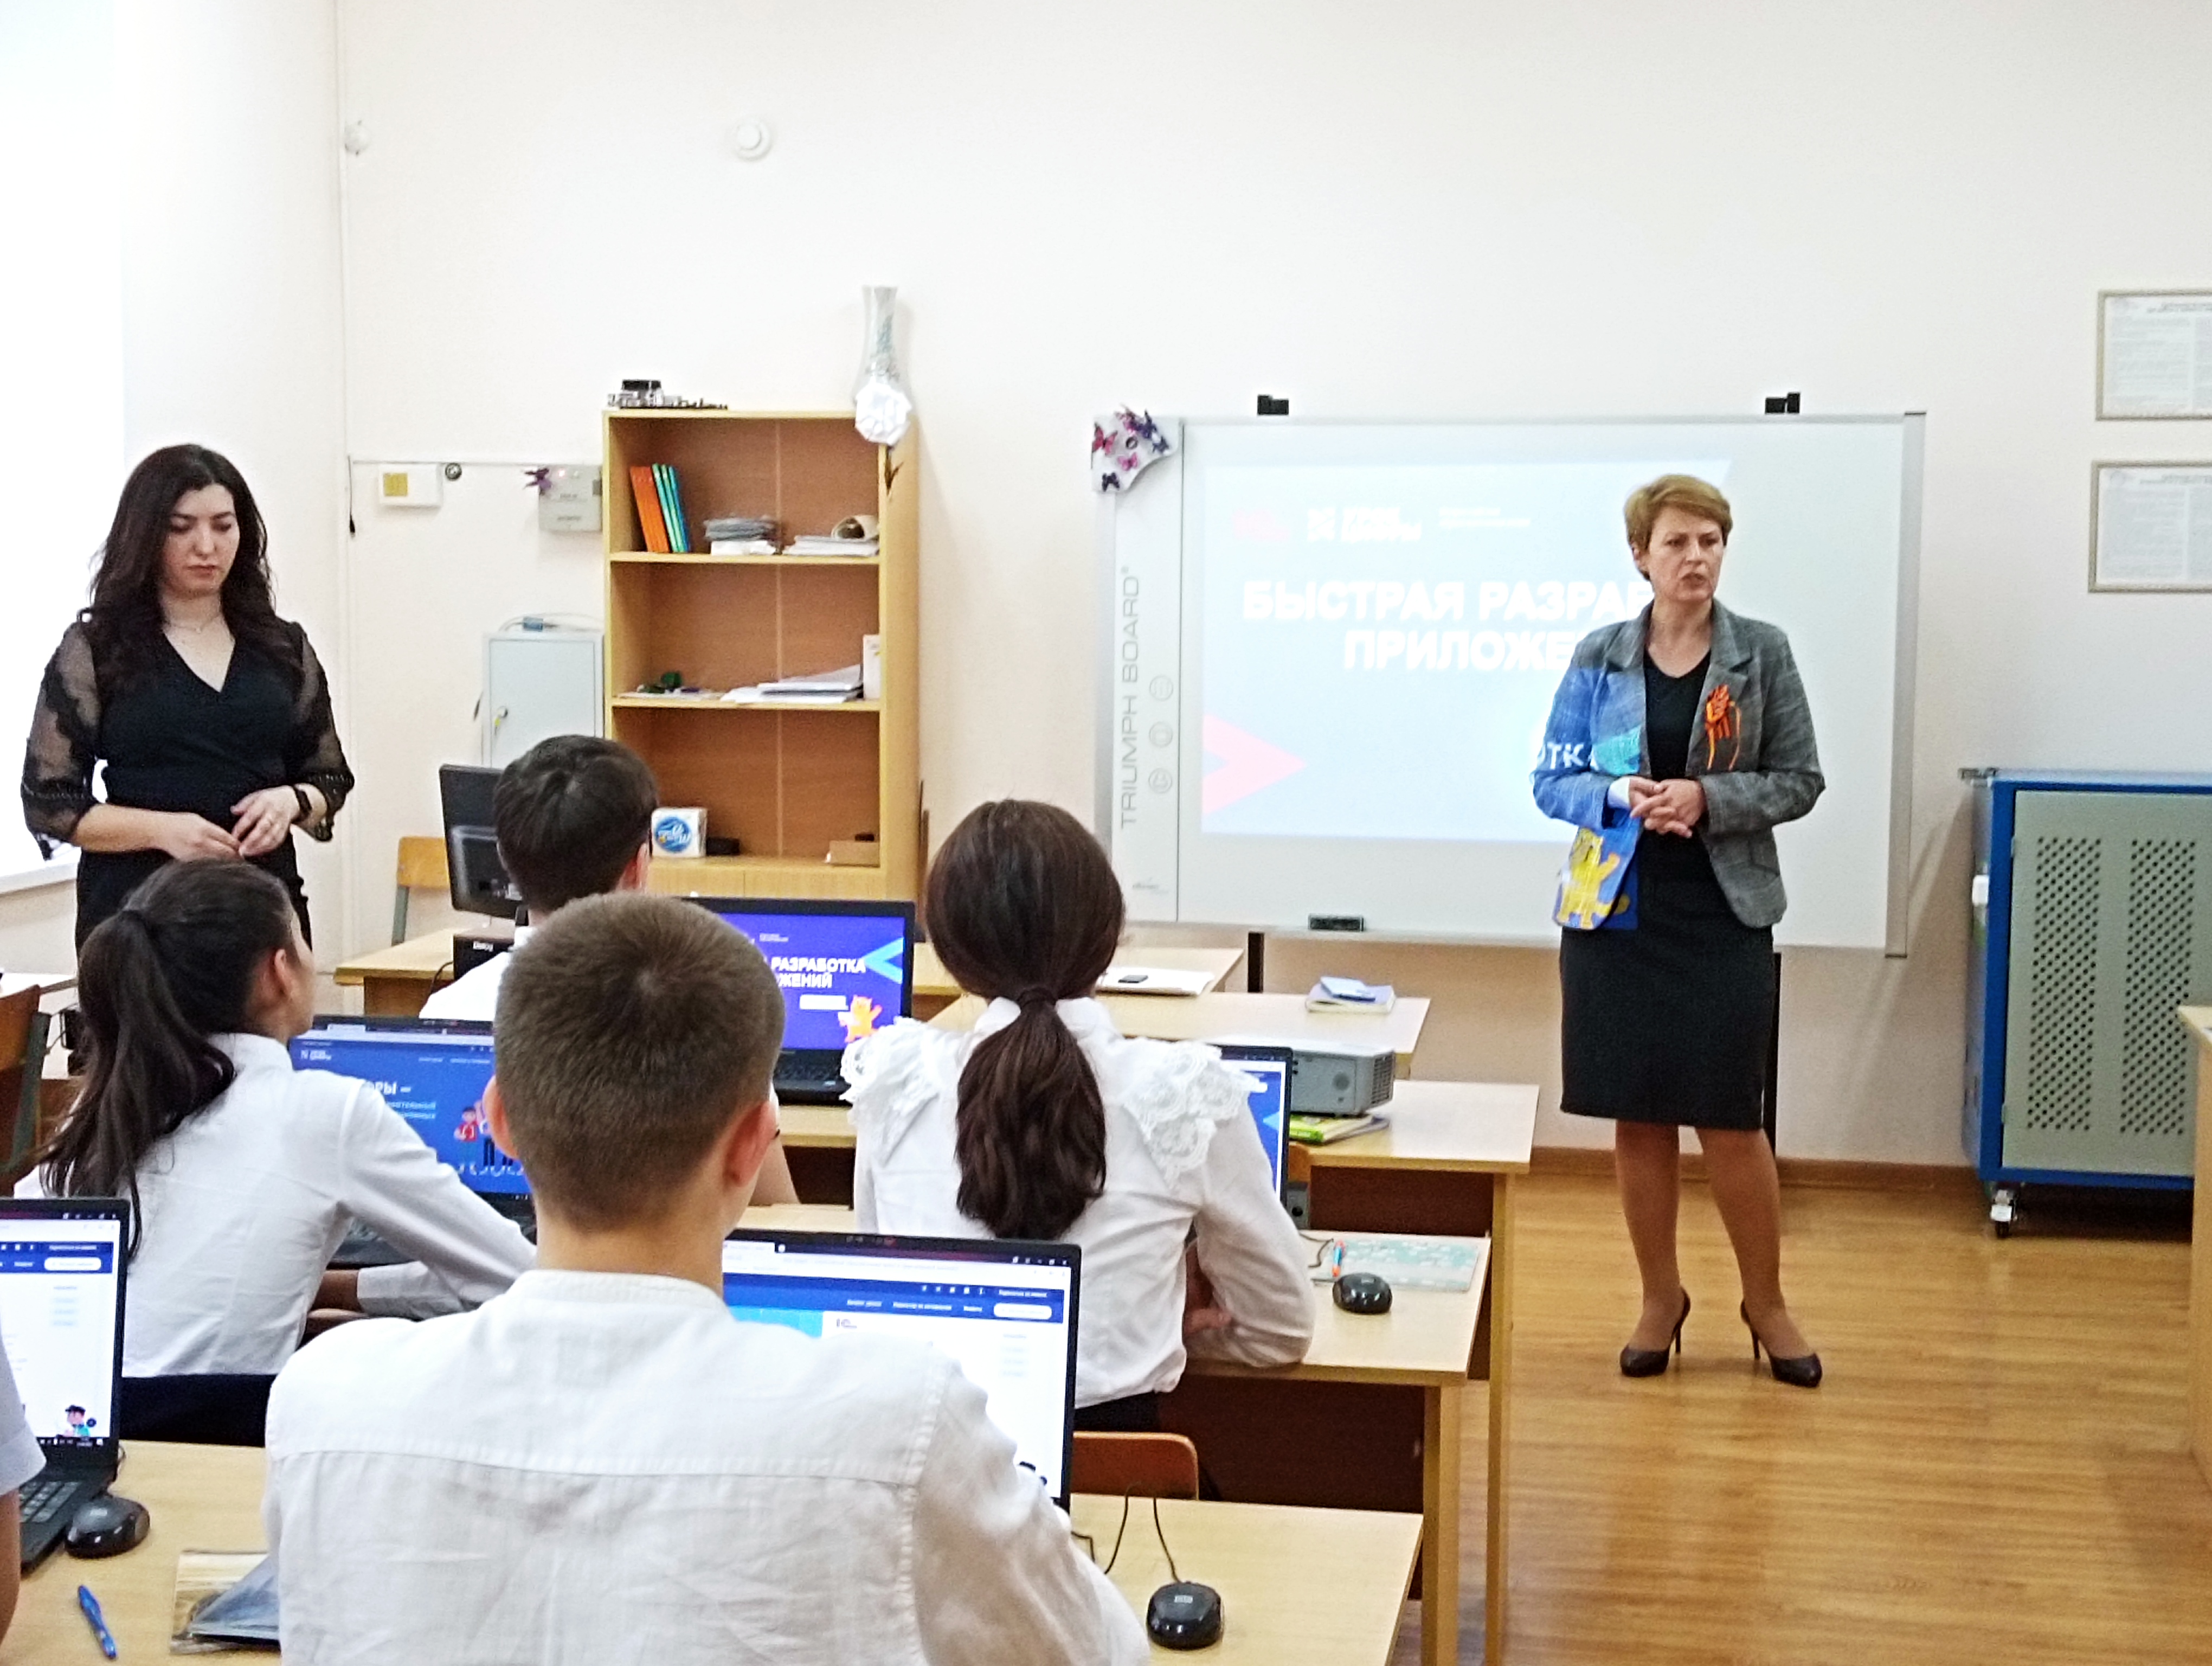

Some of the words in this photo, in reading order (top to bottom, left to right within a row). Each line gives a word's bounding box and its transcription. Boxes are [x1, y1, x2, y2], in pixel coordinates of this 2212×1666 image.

[1242, 580, 1465, 621] БЫСТРАЯ
[1343, 630, 1579, 670] ПРИЛОЖЕ
[1121, 695, 1138, 829] TRIUMPH
[770, 957, 866, 973] РАЗРАБОТКА
